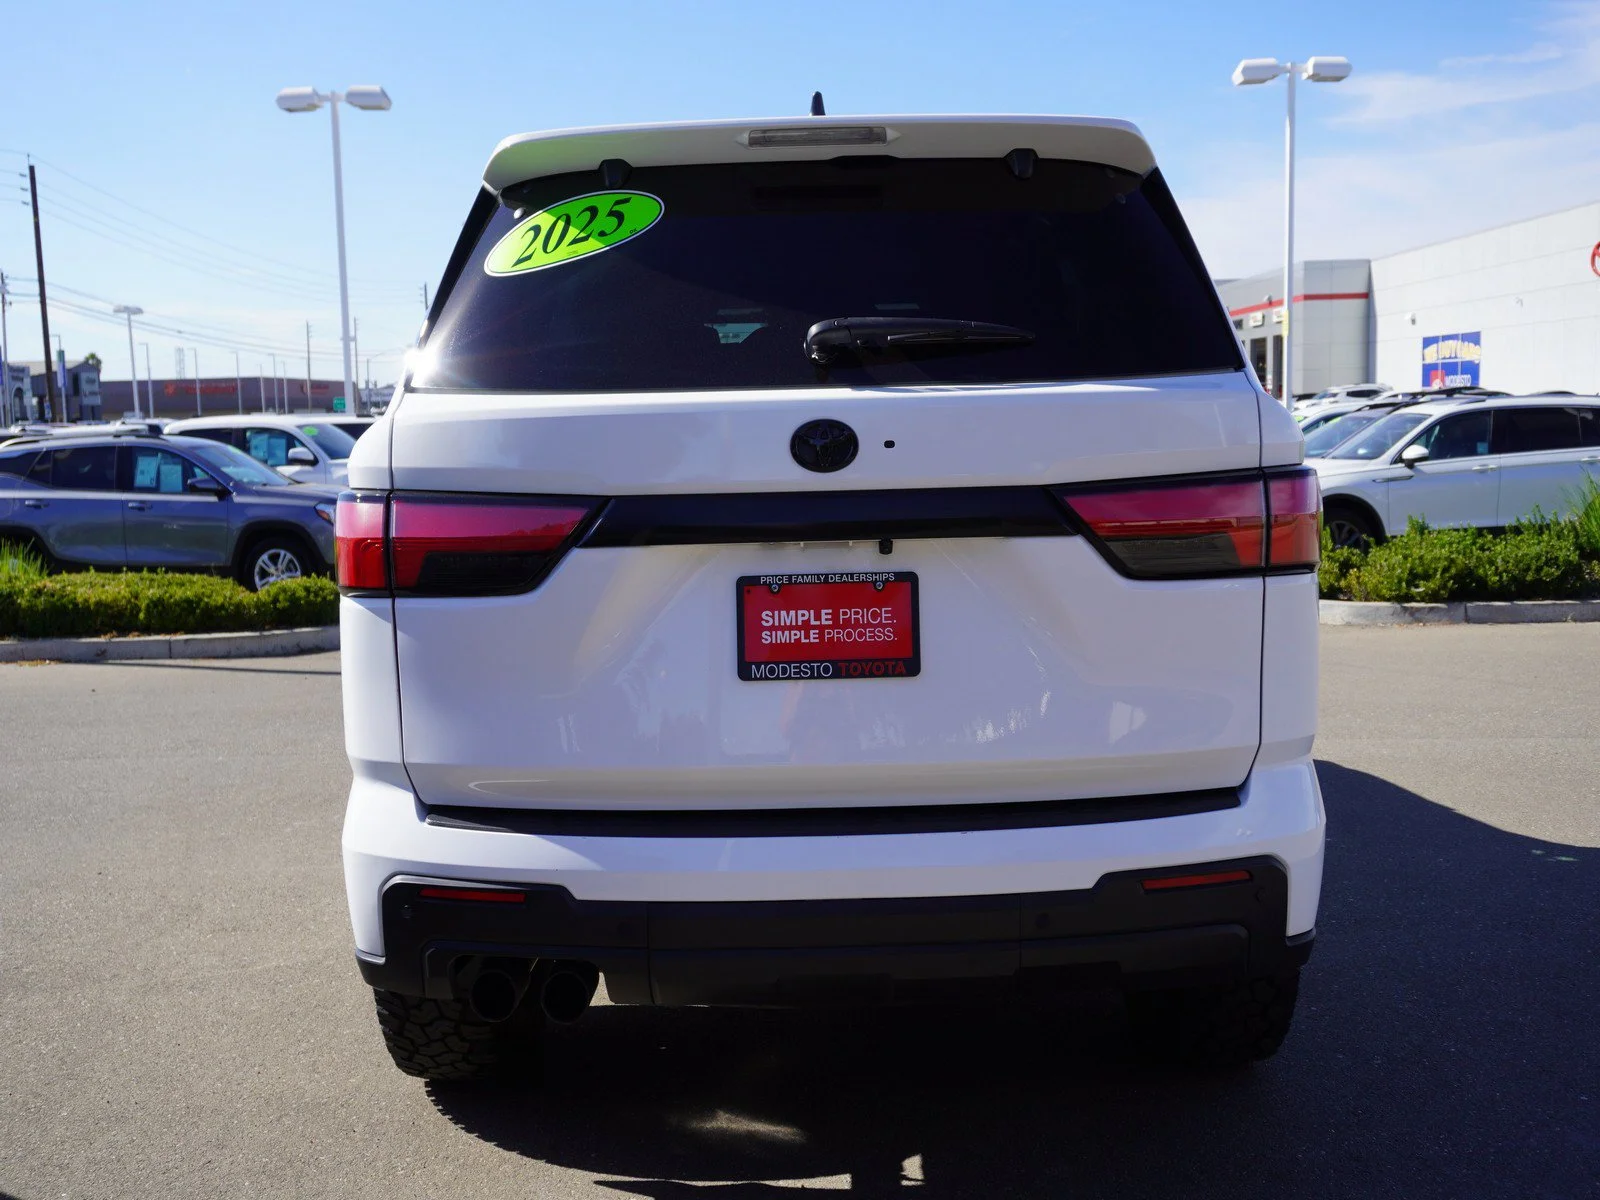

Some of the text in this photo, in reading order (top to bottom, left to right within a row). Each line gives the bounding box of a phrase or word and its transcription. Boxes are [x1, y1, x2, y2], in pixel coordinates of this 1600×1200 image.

[511, 196, 632, 268] 2025
[760, 573, 895, 585] PRICE FAMILY DEALERSHIPS
[761, 608, 897, 627] SIMPLE PRICE.
[761, 628, 898, 644] SIMPLE PROCESS.
[751, 661, 907, 679] MODESTO TOYOTA
